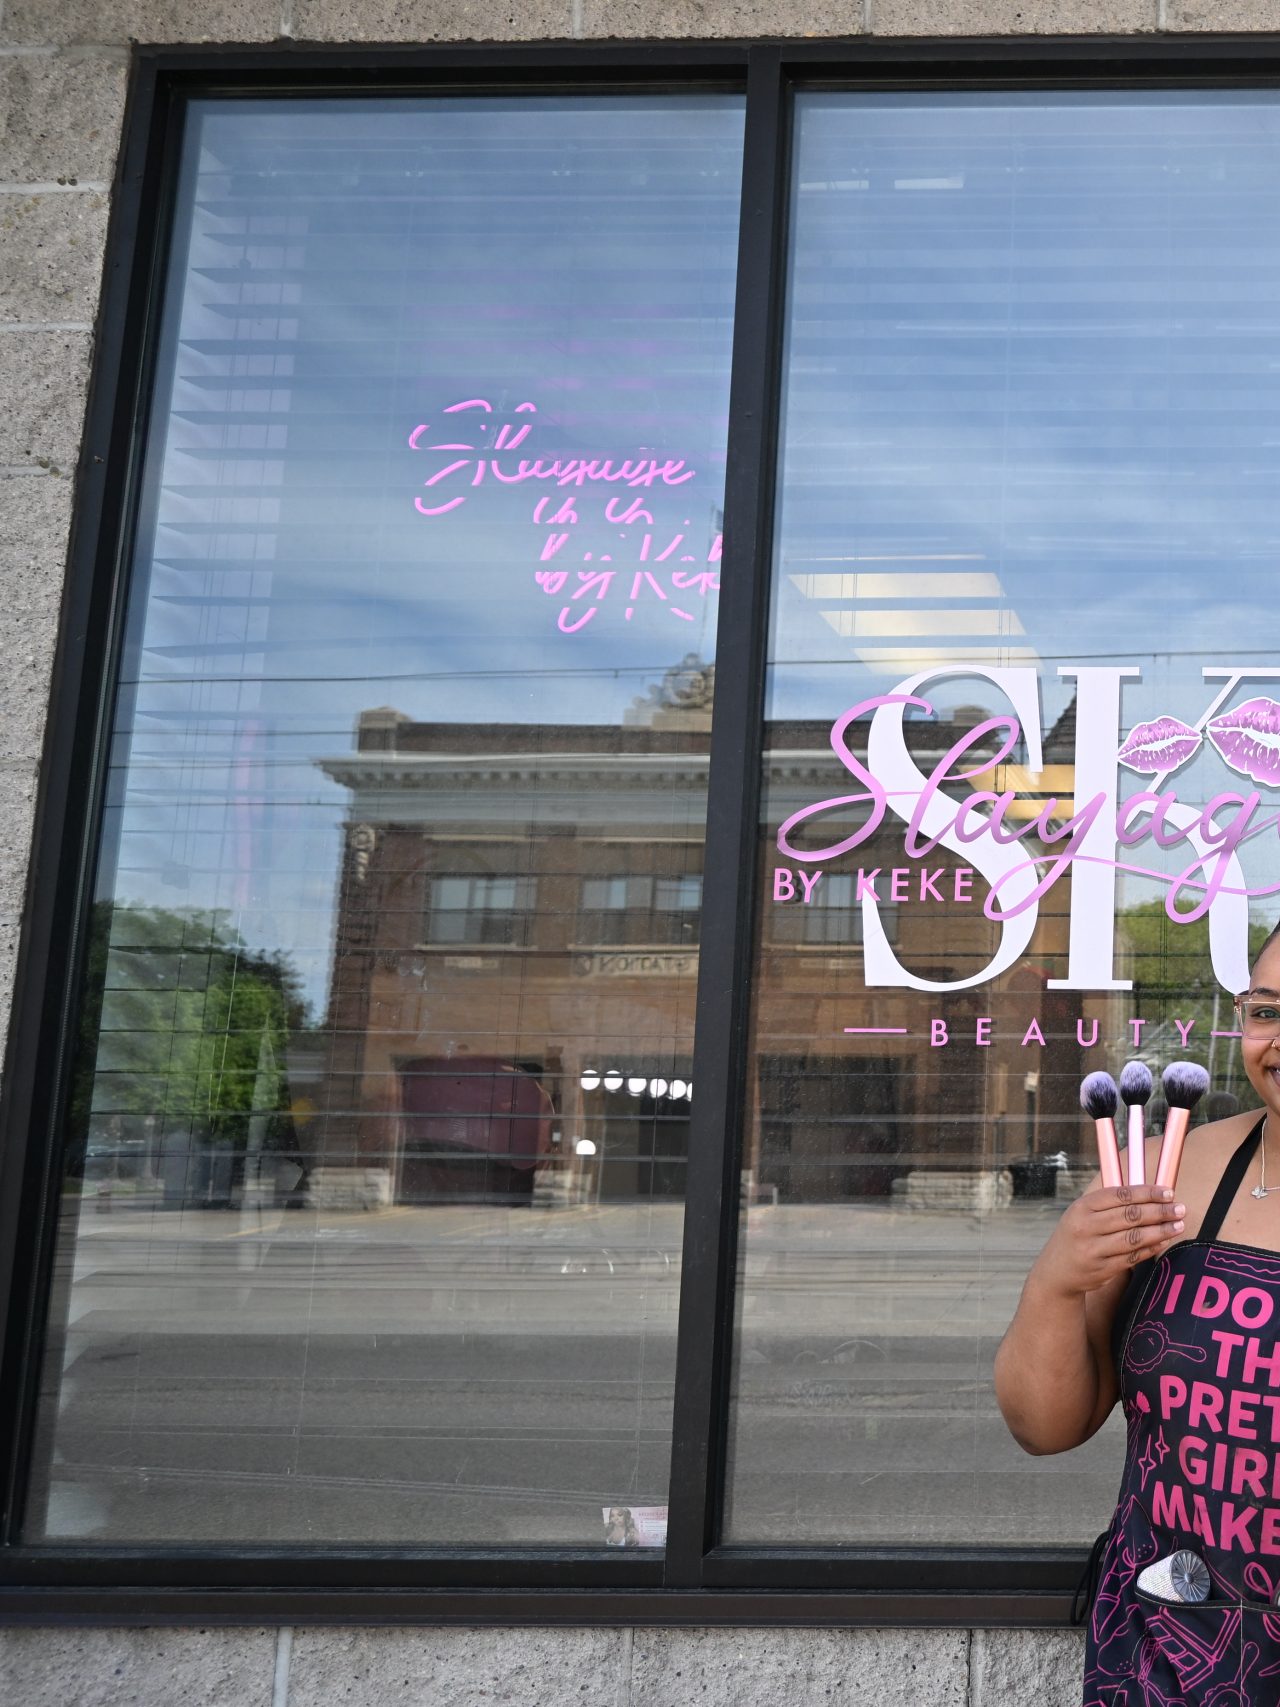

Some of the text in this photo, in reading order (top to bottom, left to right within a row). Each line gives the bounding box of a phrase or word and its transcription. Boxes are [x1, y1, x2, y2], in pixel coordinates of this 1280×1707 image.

[773, 868, 973, 903] BY KEKE
[930, 1017, 1196, 1047] BEAUTY
[1163, 1273, 1186, 1315] I
[1191, 1275, 1274, 1329] DO
